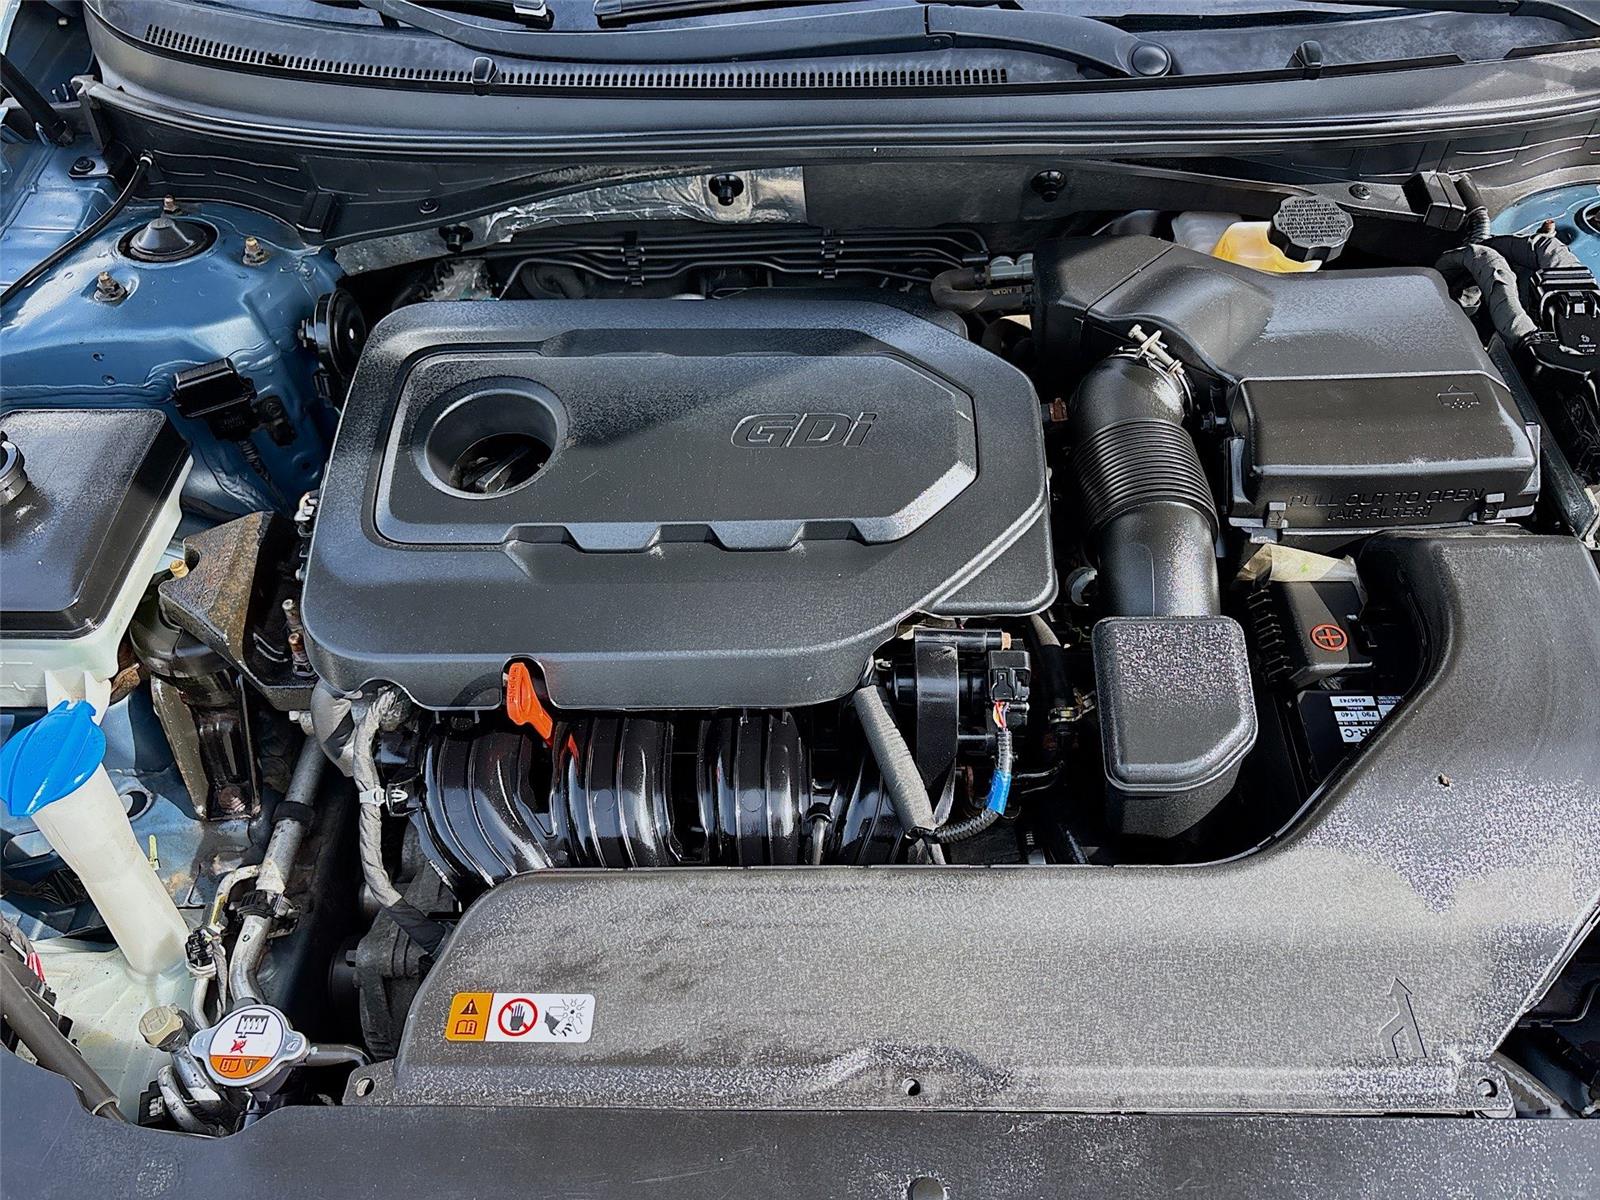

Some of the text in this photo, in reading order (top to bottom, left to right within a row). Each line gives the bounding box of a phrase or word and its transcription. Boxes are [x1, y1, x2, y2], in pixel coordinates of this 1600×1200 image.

[730, 411, 878, 448] GDi
[1287, 488, 1485, 507] PULL OUT TO OPEN
